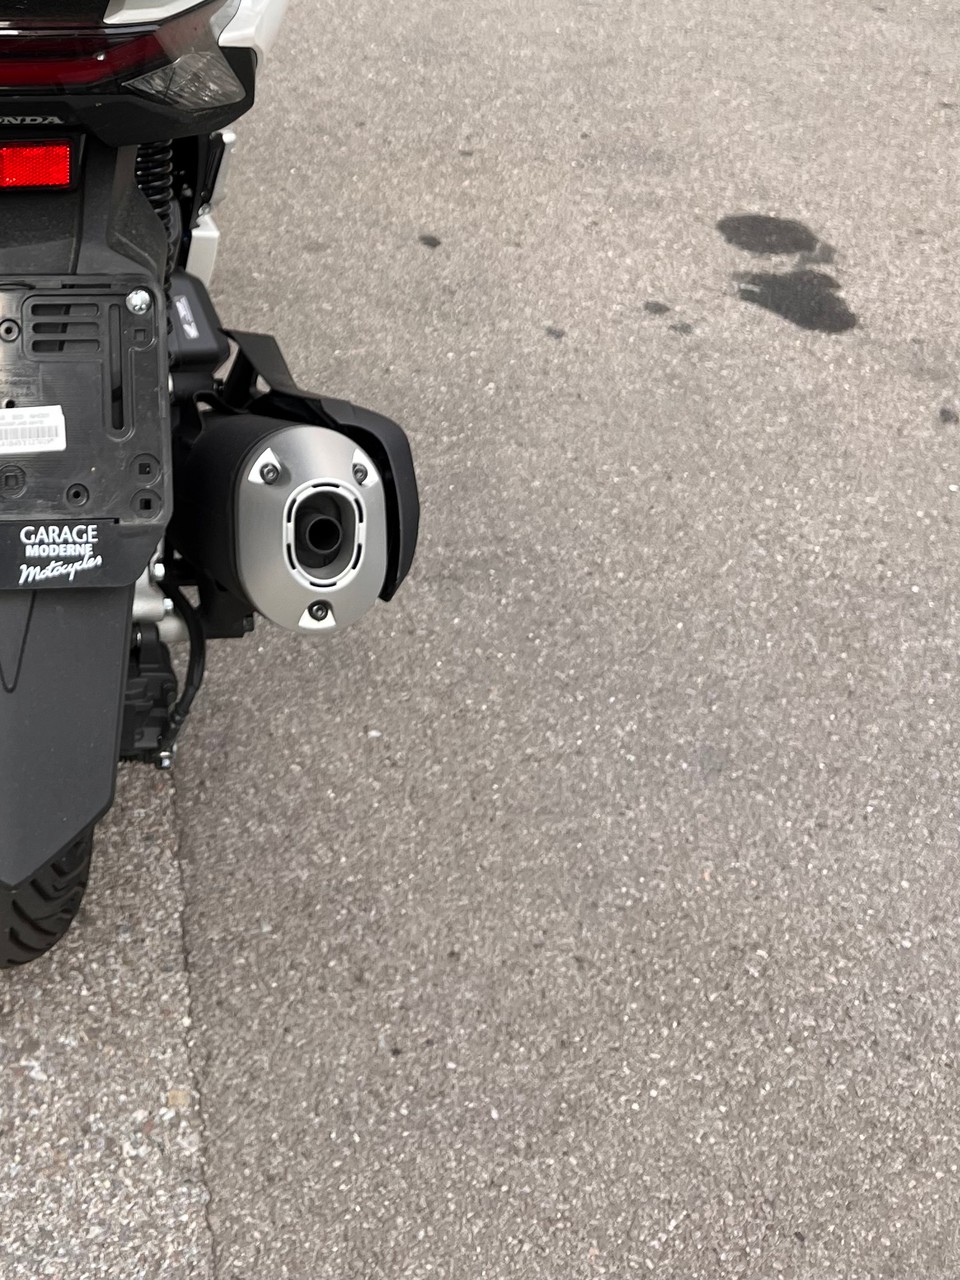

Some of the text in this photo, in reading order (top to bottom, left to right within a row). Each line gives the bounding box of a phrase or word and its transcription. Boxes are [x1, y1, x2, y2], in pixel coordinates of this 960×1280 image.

[20, 524, 98, 544] GARAGE
[25, 543, 93, 558] MODERNE
[18, 555, 103, 585] Motocycles
